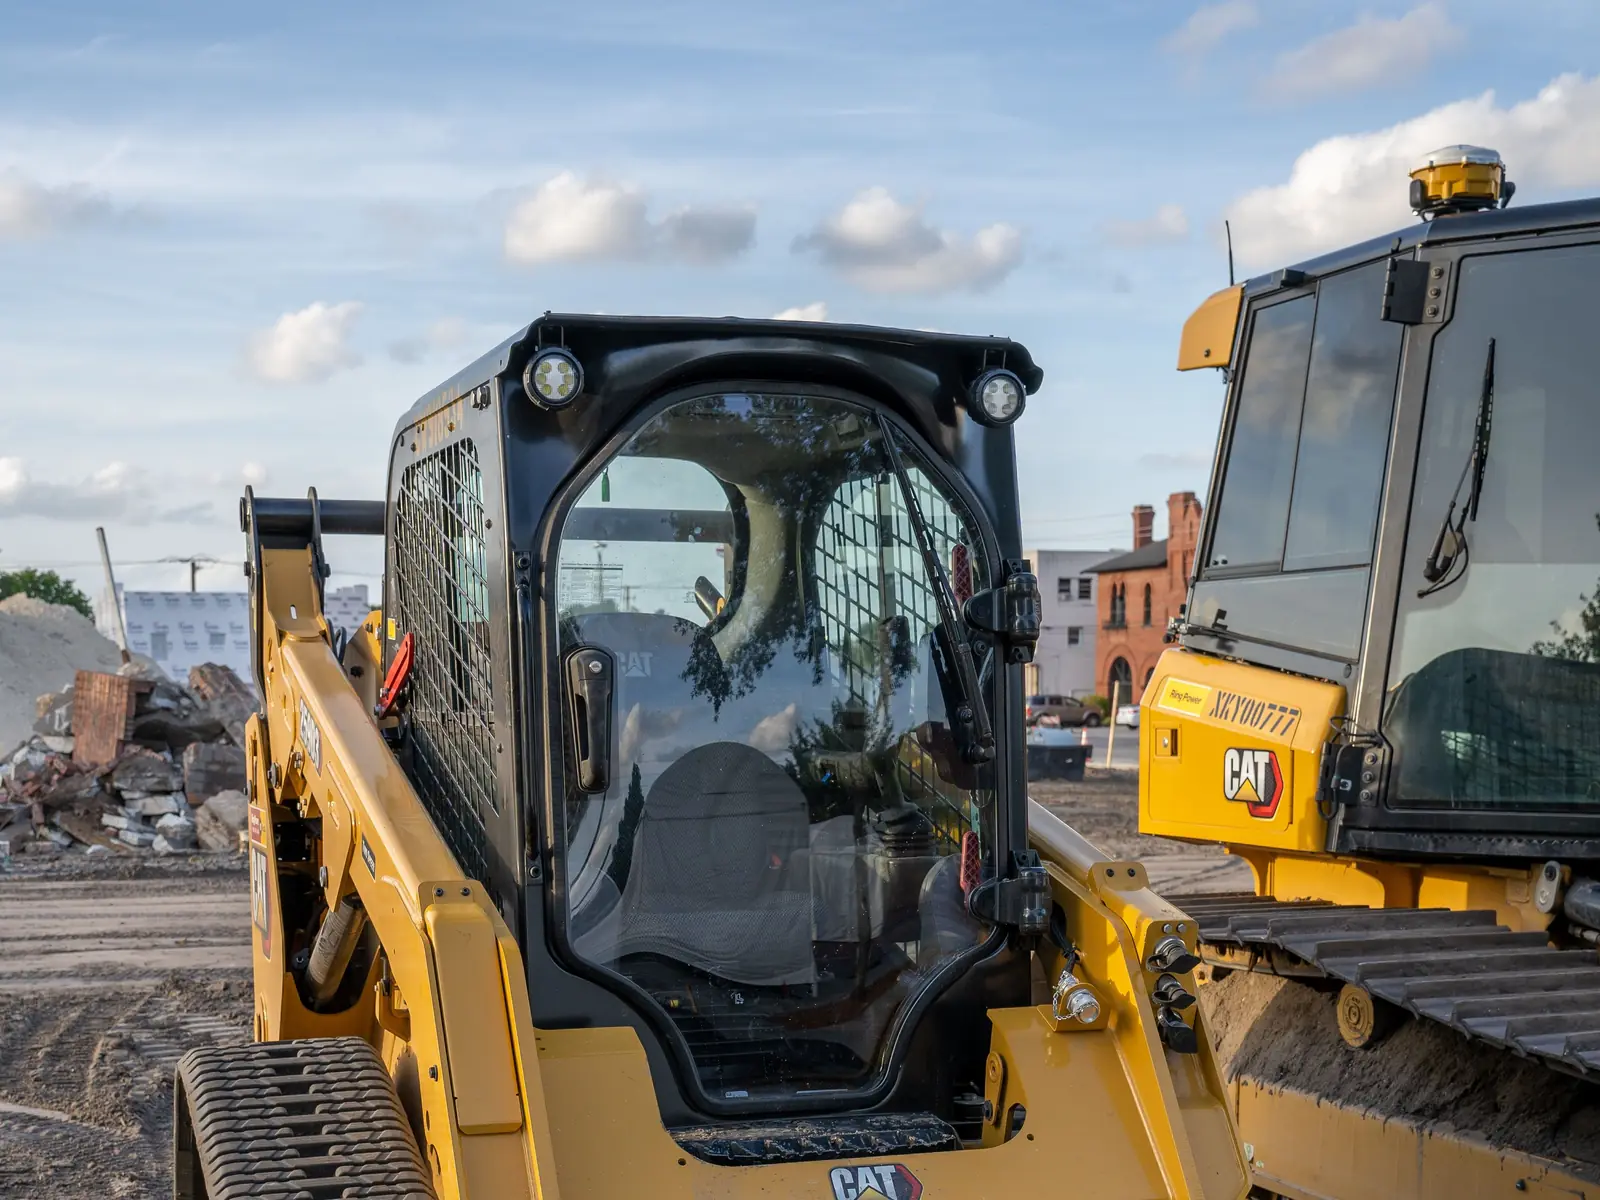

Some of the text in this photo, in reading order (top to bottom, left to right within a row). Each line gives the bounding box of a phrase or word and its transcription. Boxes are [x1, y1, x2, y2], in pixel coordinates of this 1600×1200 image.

[1182, 692, 1202, 704] Power
[1226, 749, 1270, 802] CAT
[252, 848, 267, 932] CAT
[830, 1165, 898, 1200] CAT
